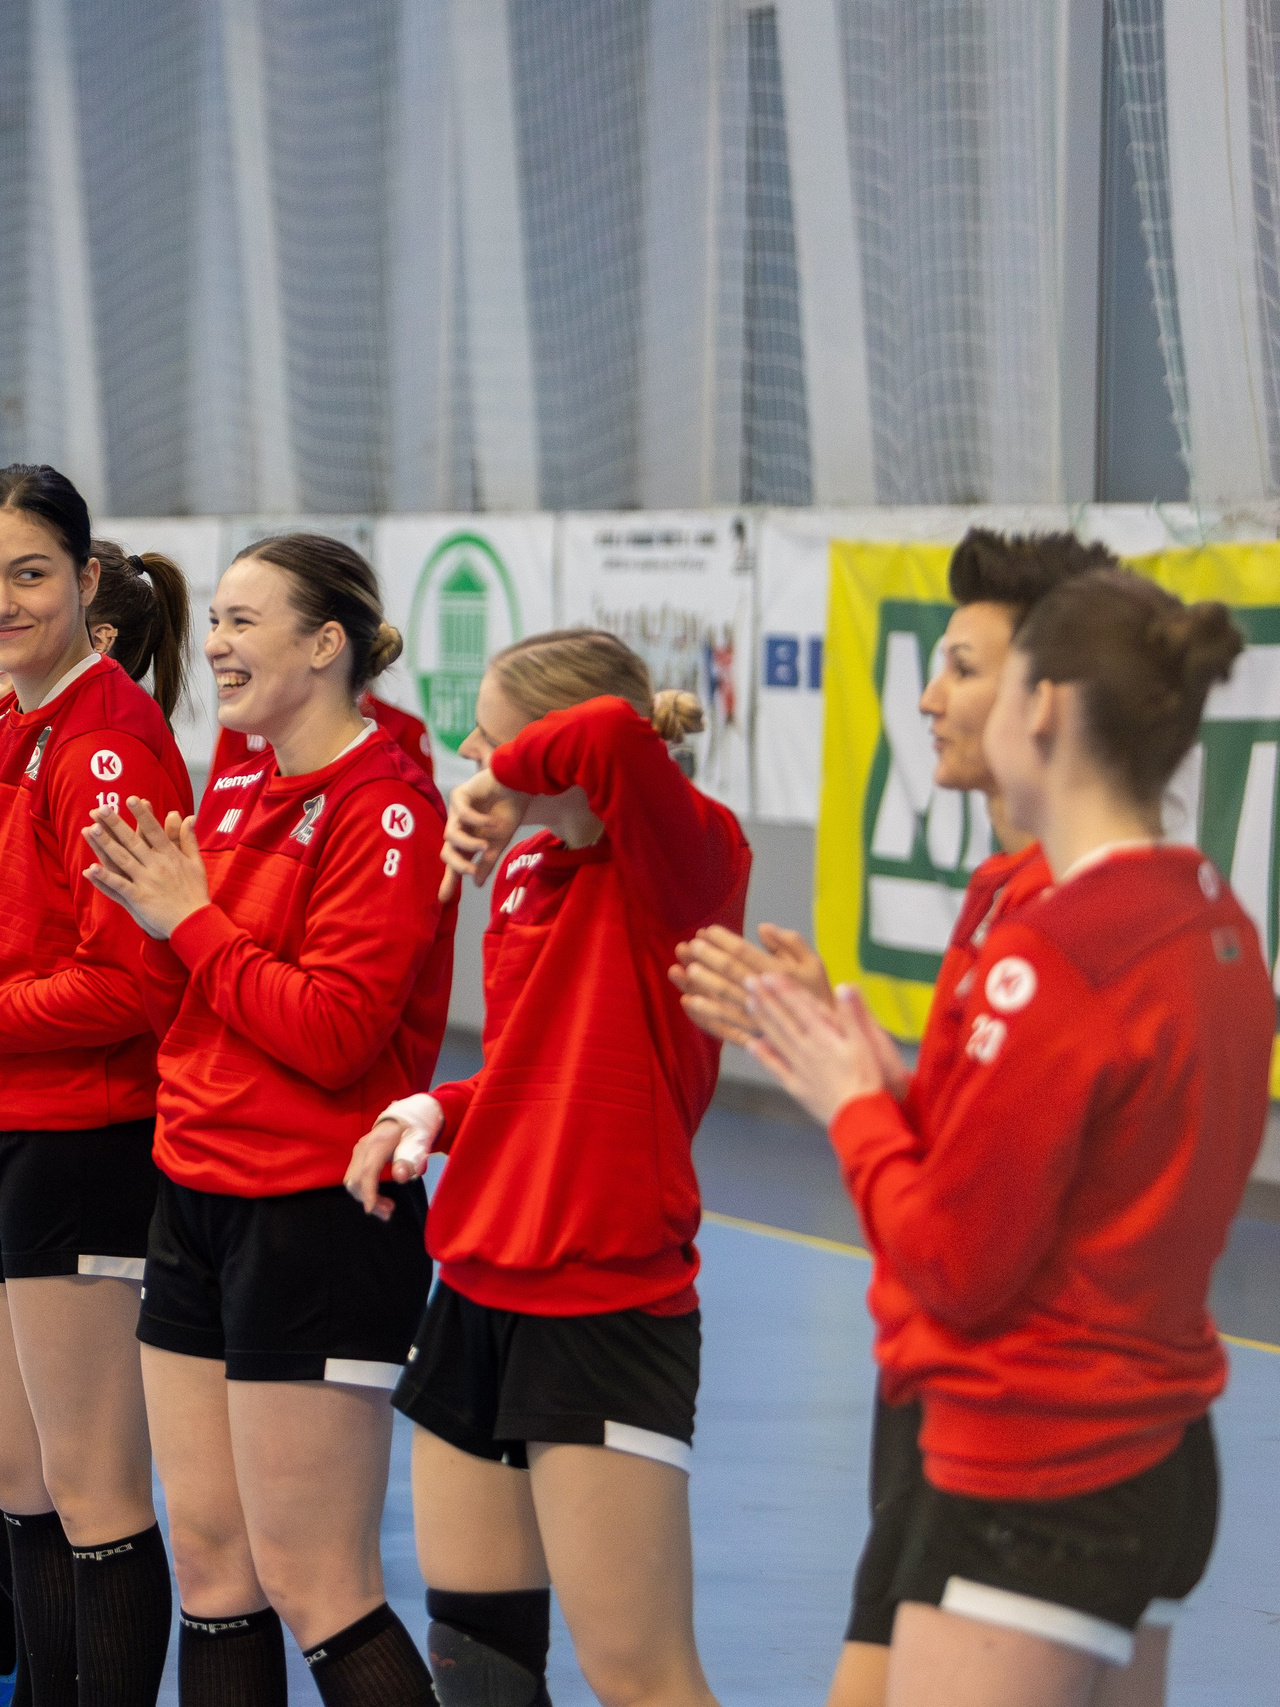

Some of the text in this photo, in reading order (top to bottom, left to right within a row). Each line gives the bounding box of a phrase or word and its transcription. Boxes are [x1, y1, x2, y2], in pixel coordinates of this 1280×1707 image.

[213, 769, 264, 791] Kempa
[95, 791, 120, 815] 18
[383, 848, 401, 877] 8
